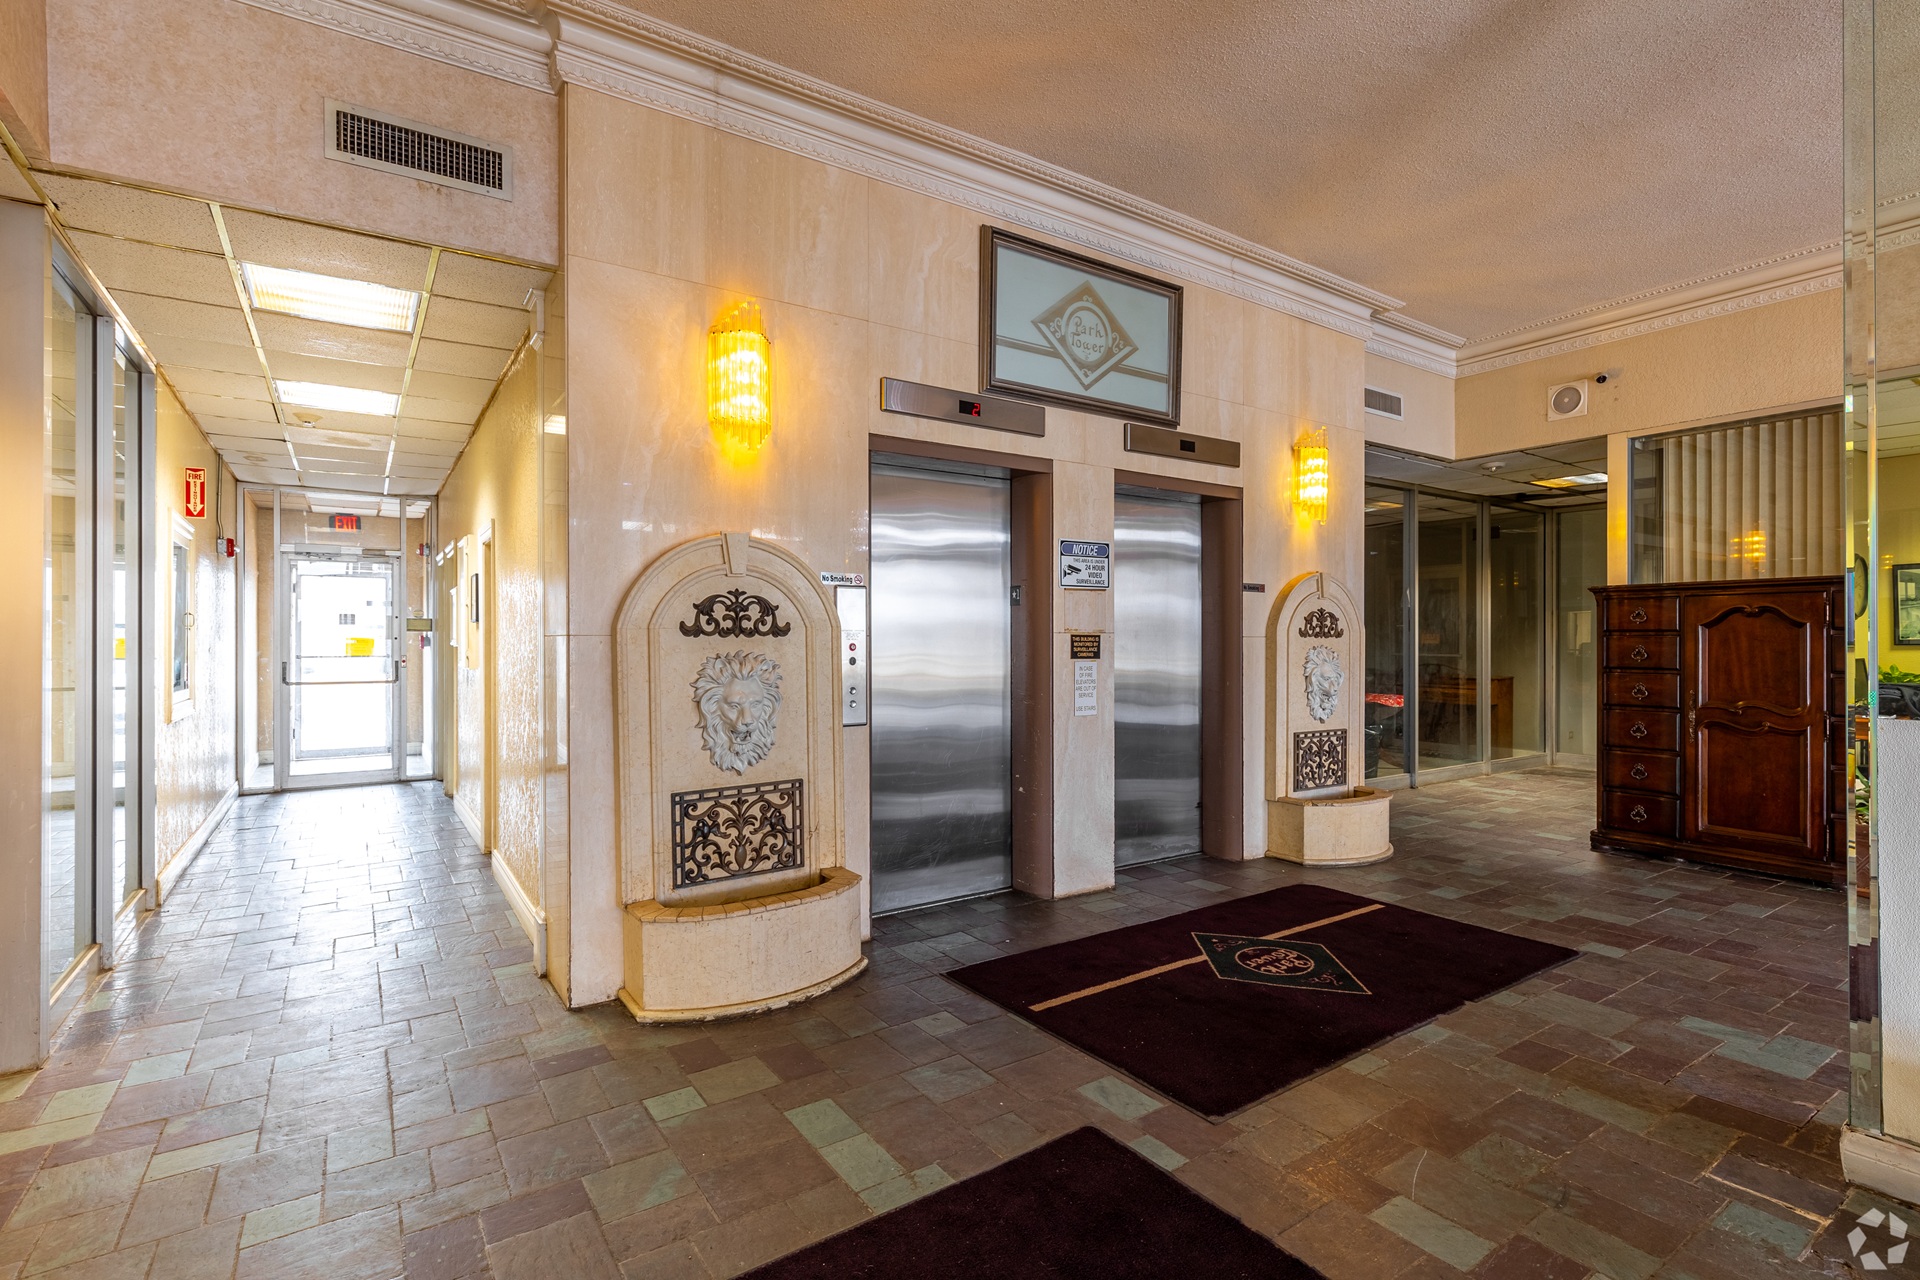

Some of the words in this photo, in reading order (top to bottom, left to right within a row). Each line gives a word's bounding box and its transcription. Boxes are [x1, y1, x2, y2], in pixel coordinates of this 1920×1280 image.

[1073, 316, 1104, 338] Park
[1070, 332, 1104, 353] Tower
[972, 403, 980, 417] 2
[335, 516, 357, 533] EXIT
[1072, 544, 1098, 555] NOTICE
[830, 574, 853, 584] Smoking
[1245, 949, 1297, 967] Tower
[1261, 958, 1311, 974] Park
